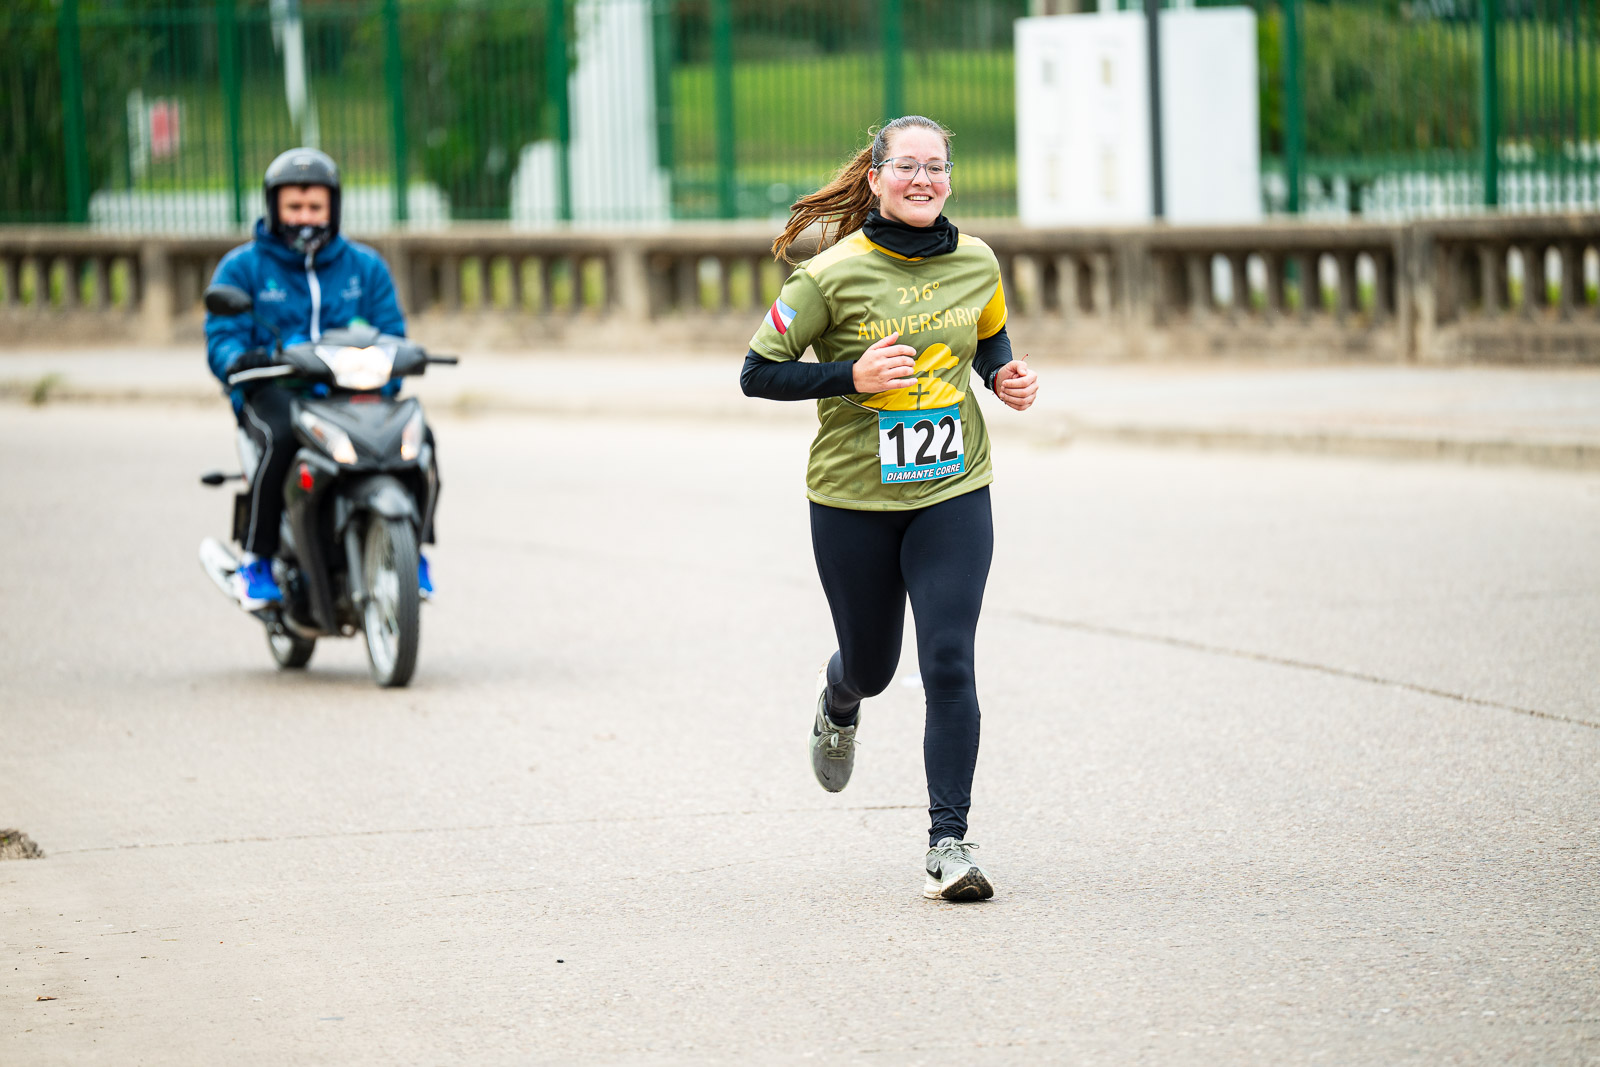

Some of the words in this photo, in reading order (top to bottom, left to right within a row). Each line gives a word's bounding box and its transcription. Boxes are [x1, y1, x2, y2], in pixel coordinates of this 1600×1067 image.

[857, 307, 981, 340] ANIVERSARIO
[887, 415, 958, 468] 122
[886, 468, 935, 481] DIAMANTE
[935, 463, 961, 476] CORRE
